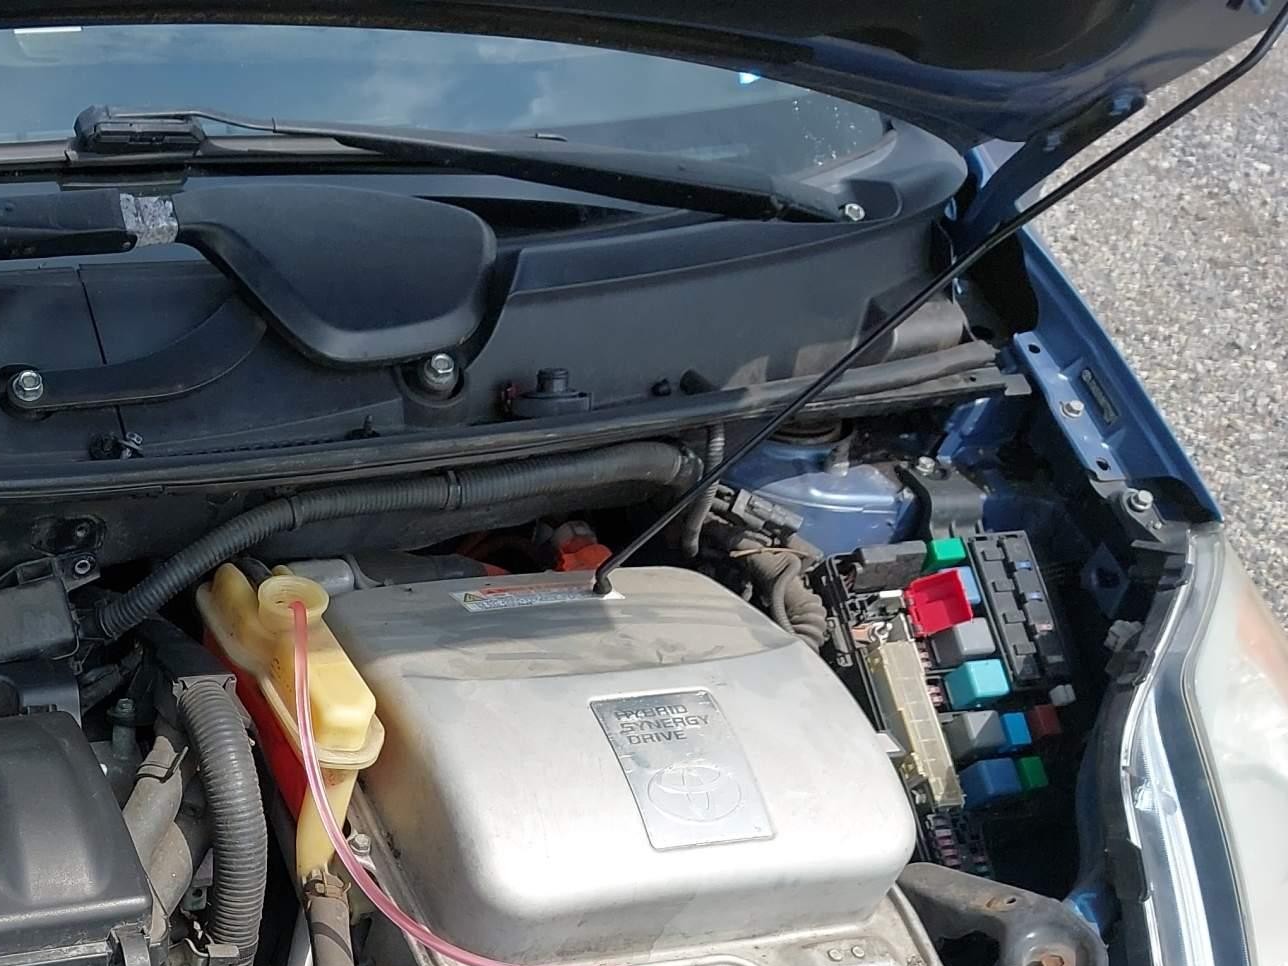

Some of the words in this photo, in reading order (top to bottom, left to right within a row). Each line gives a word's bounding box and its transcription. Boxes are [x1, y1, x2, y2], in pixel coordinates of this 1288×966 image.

[615, 704, 688, 720] HYBRID
[620, 715, 710, 734] SYNERGY
[627, 730, 688, 745] DRIVE
